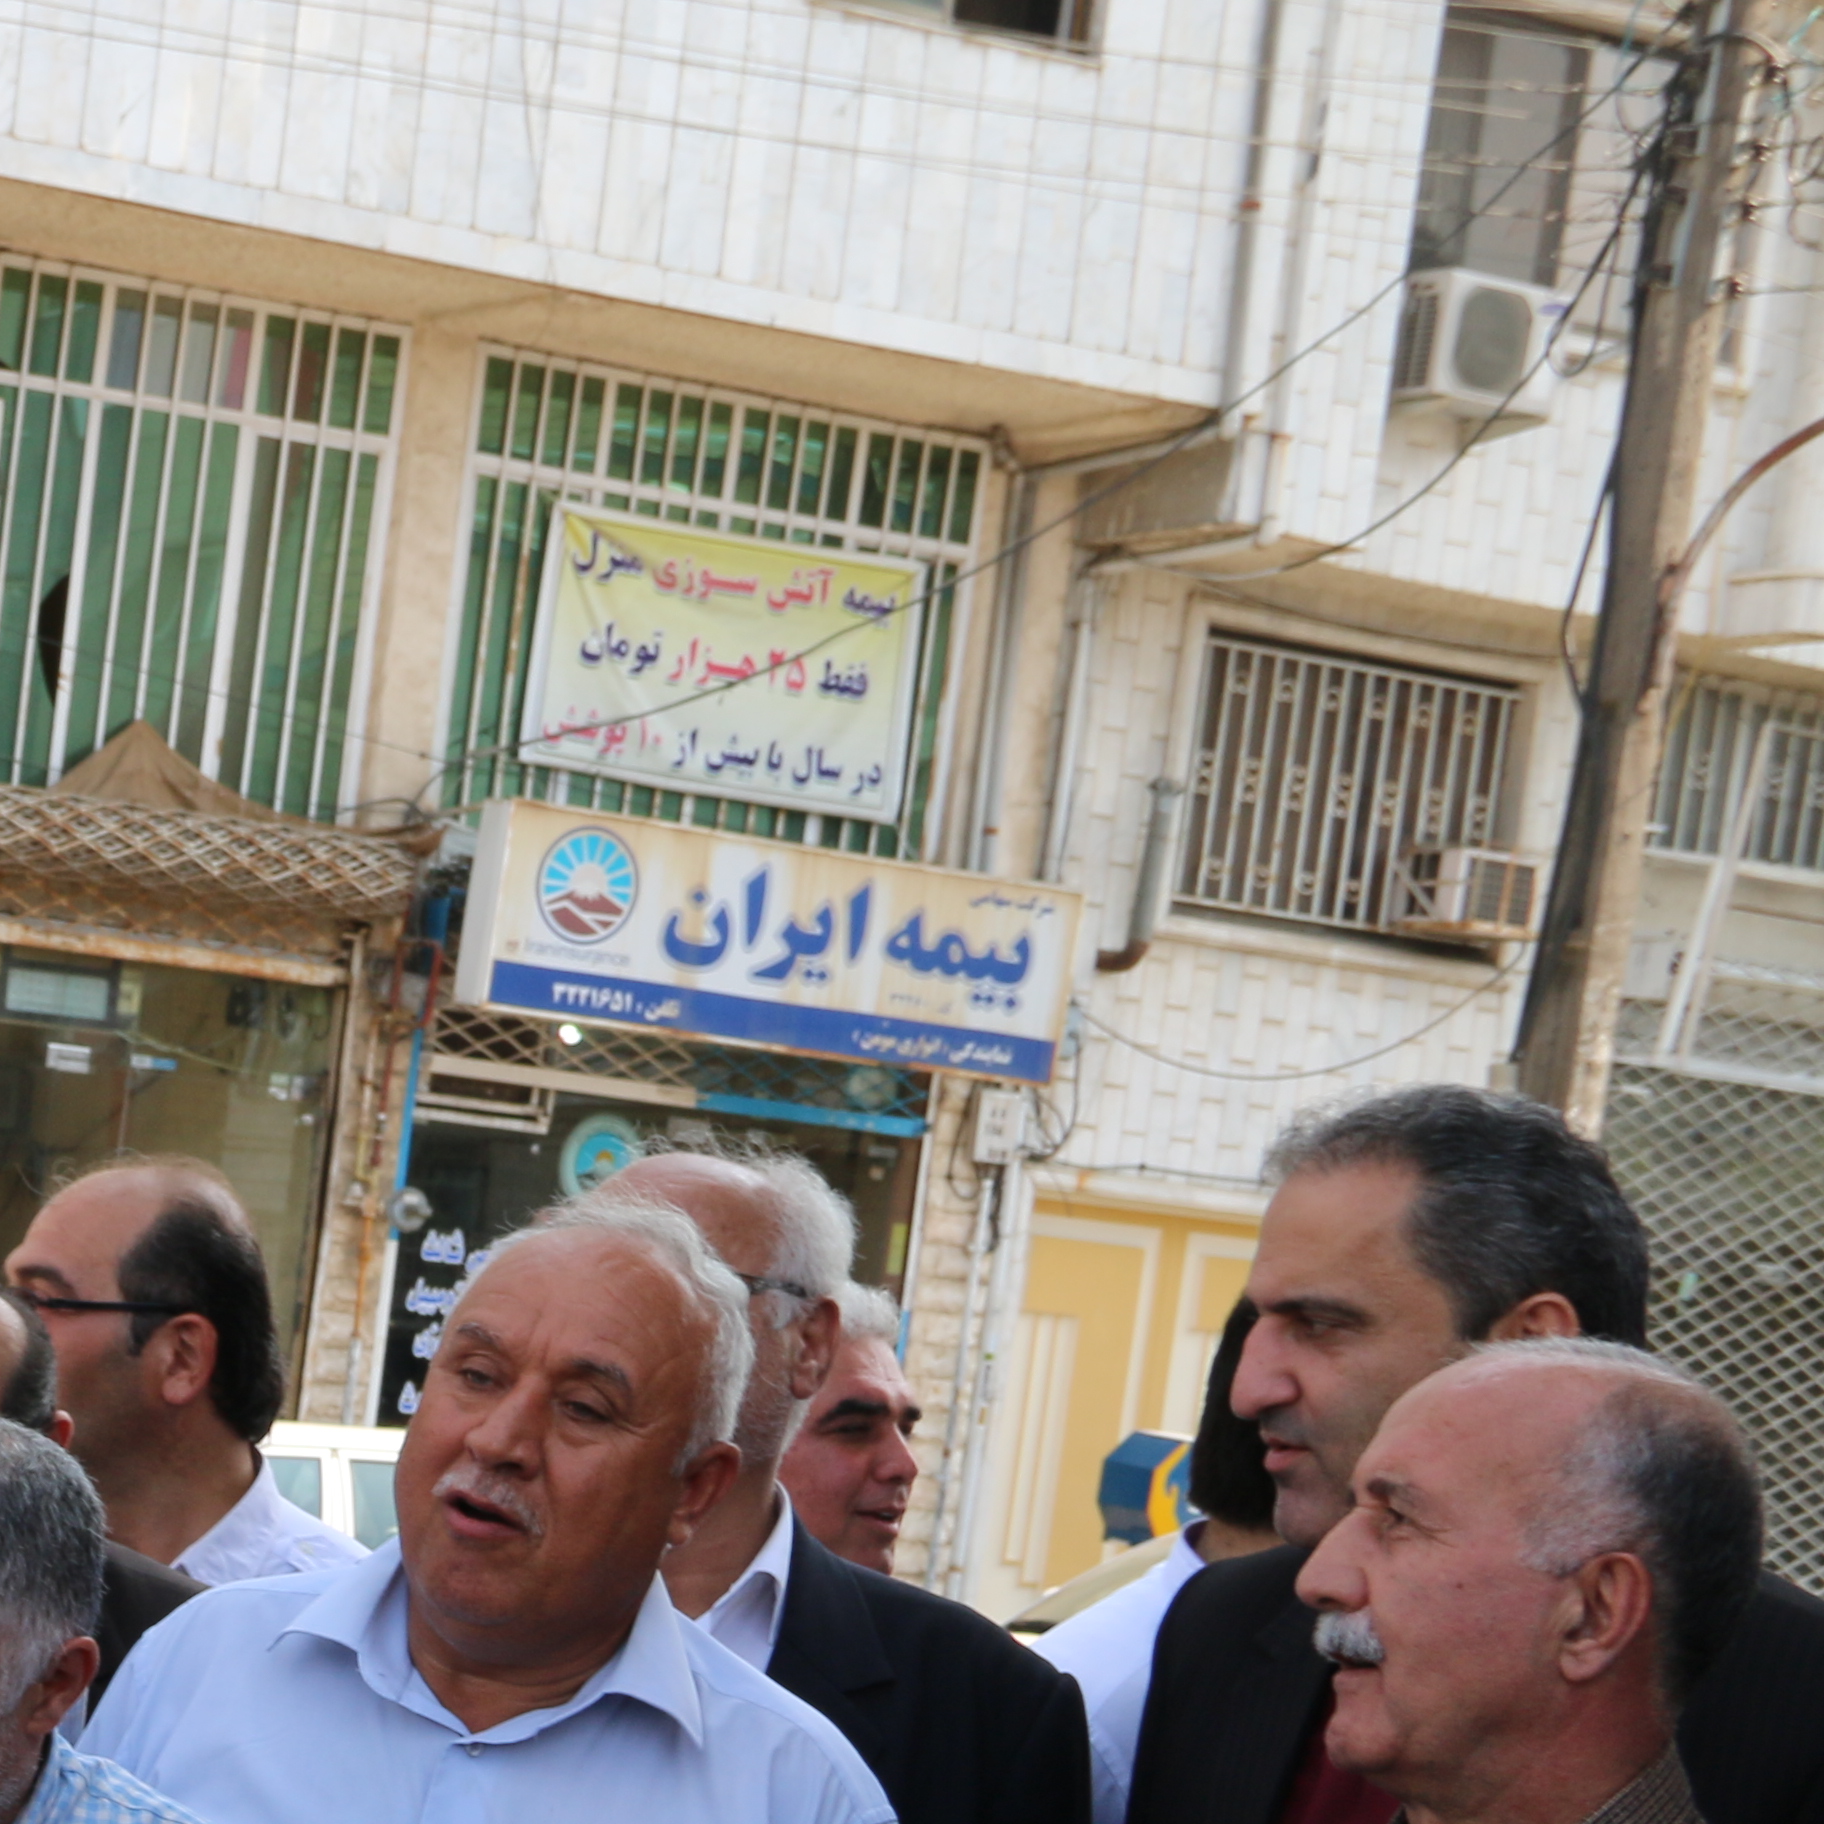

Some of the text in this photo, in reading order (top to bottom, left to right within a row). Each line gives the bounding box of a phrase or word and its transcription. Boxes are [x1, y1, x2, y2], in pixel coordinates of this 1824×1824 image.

[571, 529, 897, 629] بیمه آتش سوزی منزل
[578, 621, 870, 700] فقط ۲۵ هزار تومان
[671, 728, 699, 771] از
[704, 732, 760, 779] بیش
[766, 740, 785, 778] با
[792, 745, 843, 787] سال
[851, 760, 884, 796] در
[660, 862, 1032, 1009] بیمه ایران
